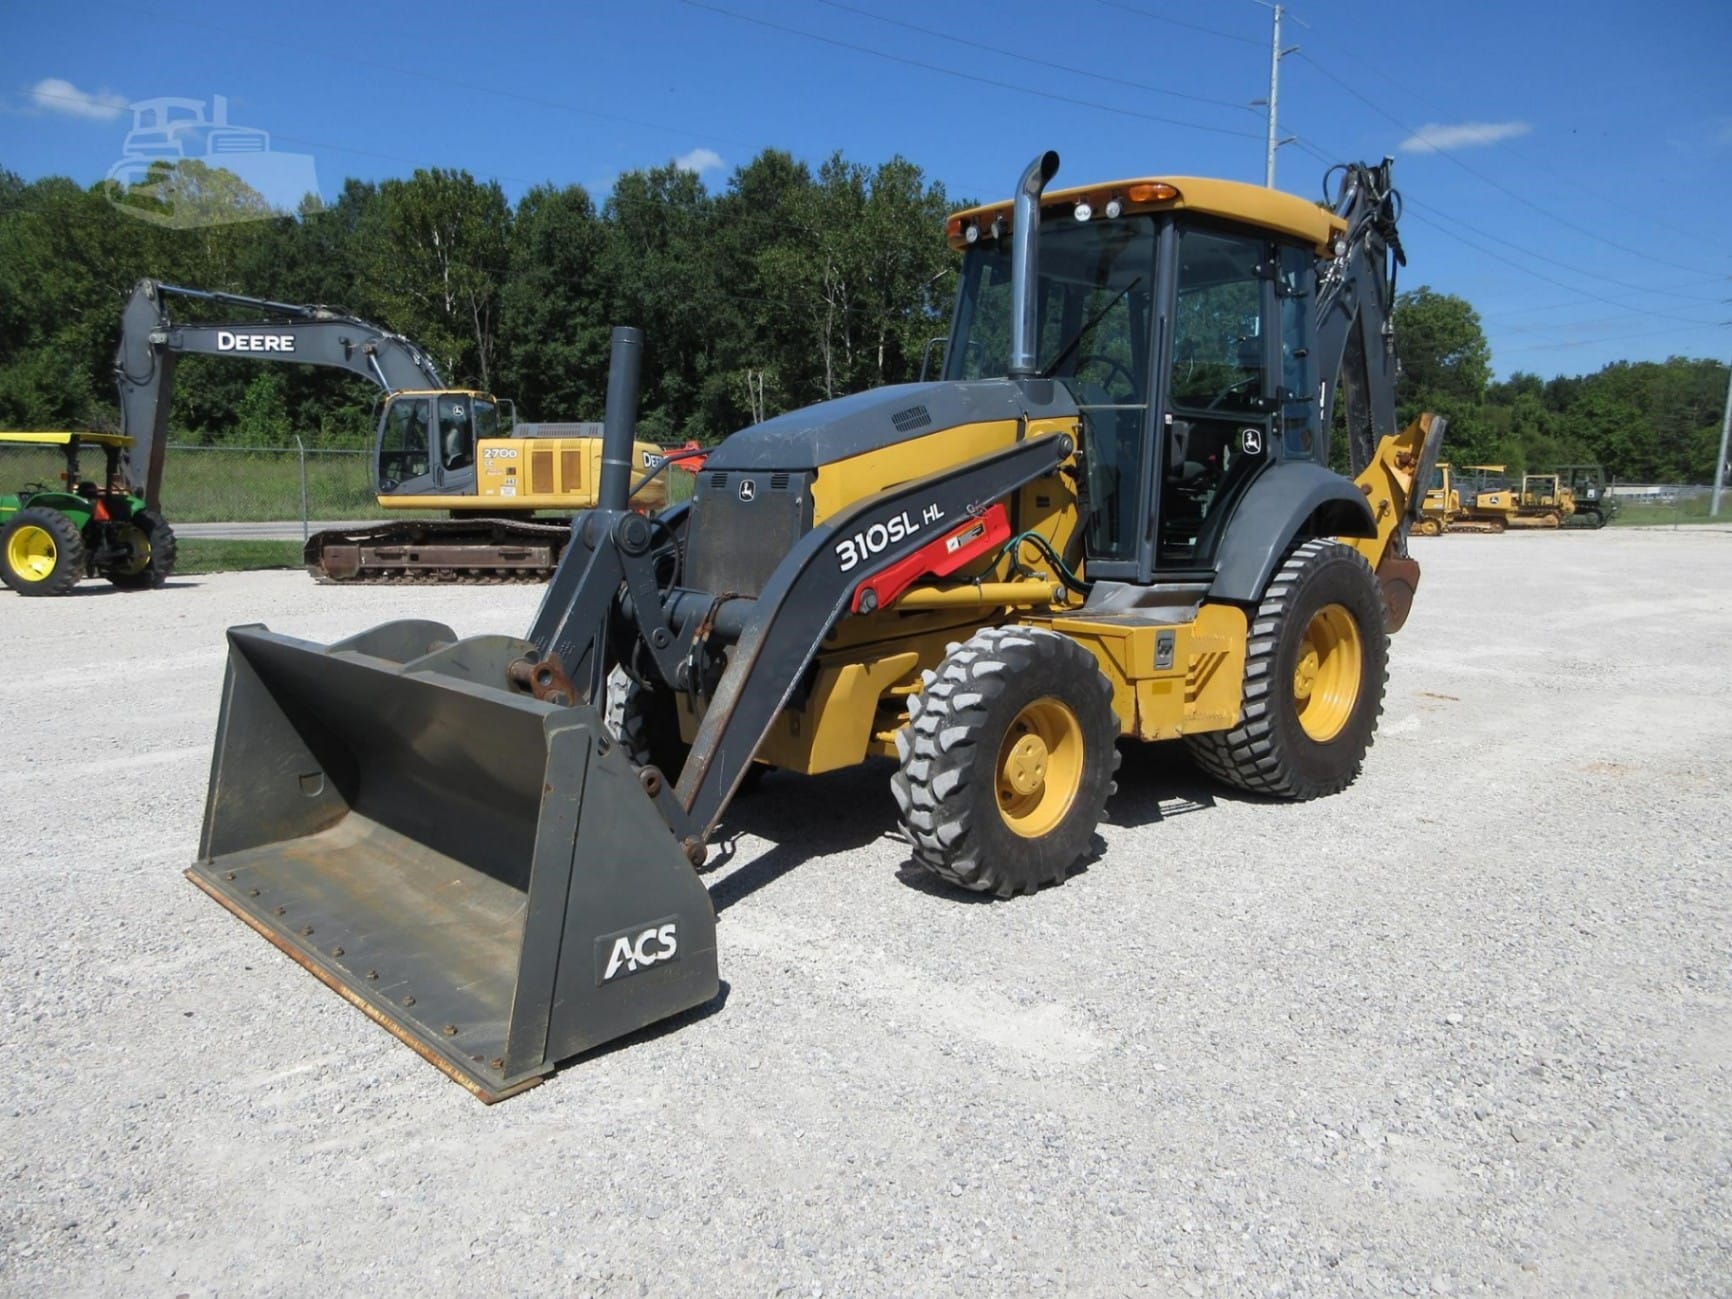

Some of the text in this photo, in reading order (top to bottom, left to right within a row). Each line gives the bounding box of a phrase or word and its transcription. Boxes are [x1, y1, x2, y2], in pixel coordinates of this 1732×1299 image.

[217, 331, 295, 352] DEERE
[835, 511, 920, 572] 310SL
[922, 503, 945, 525] HL
[603, 923, 677, 980] ACS
